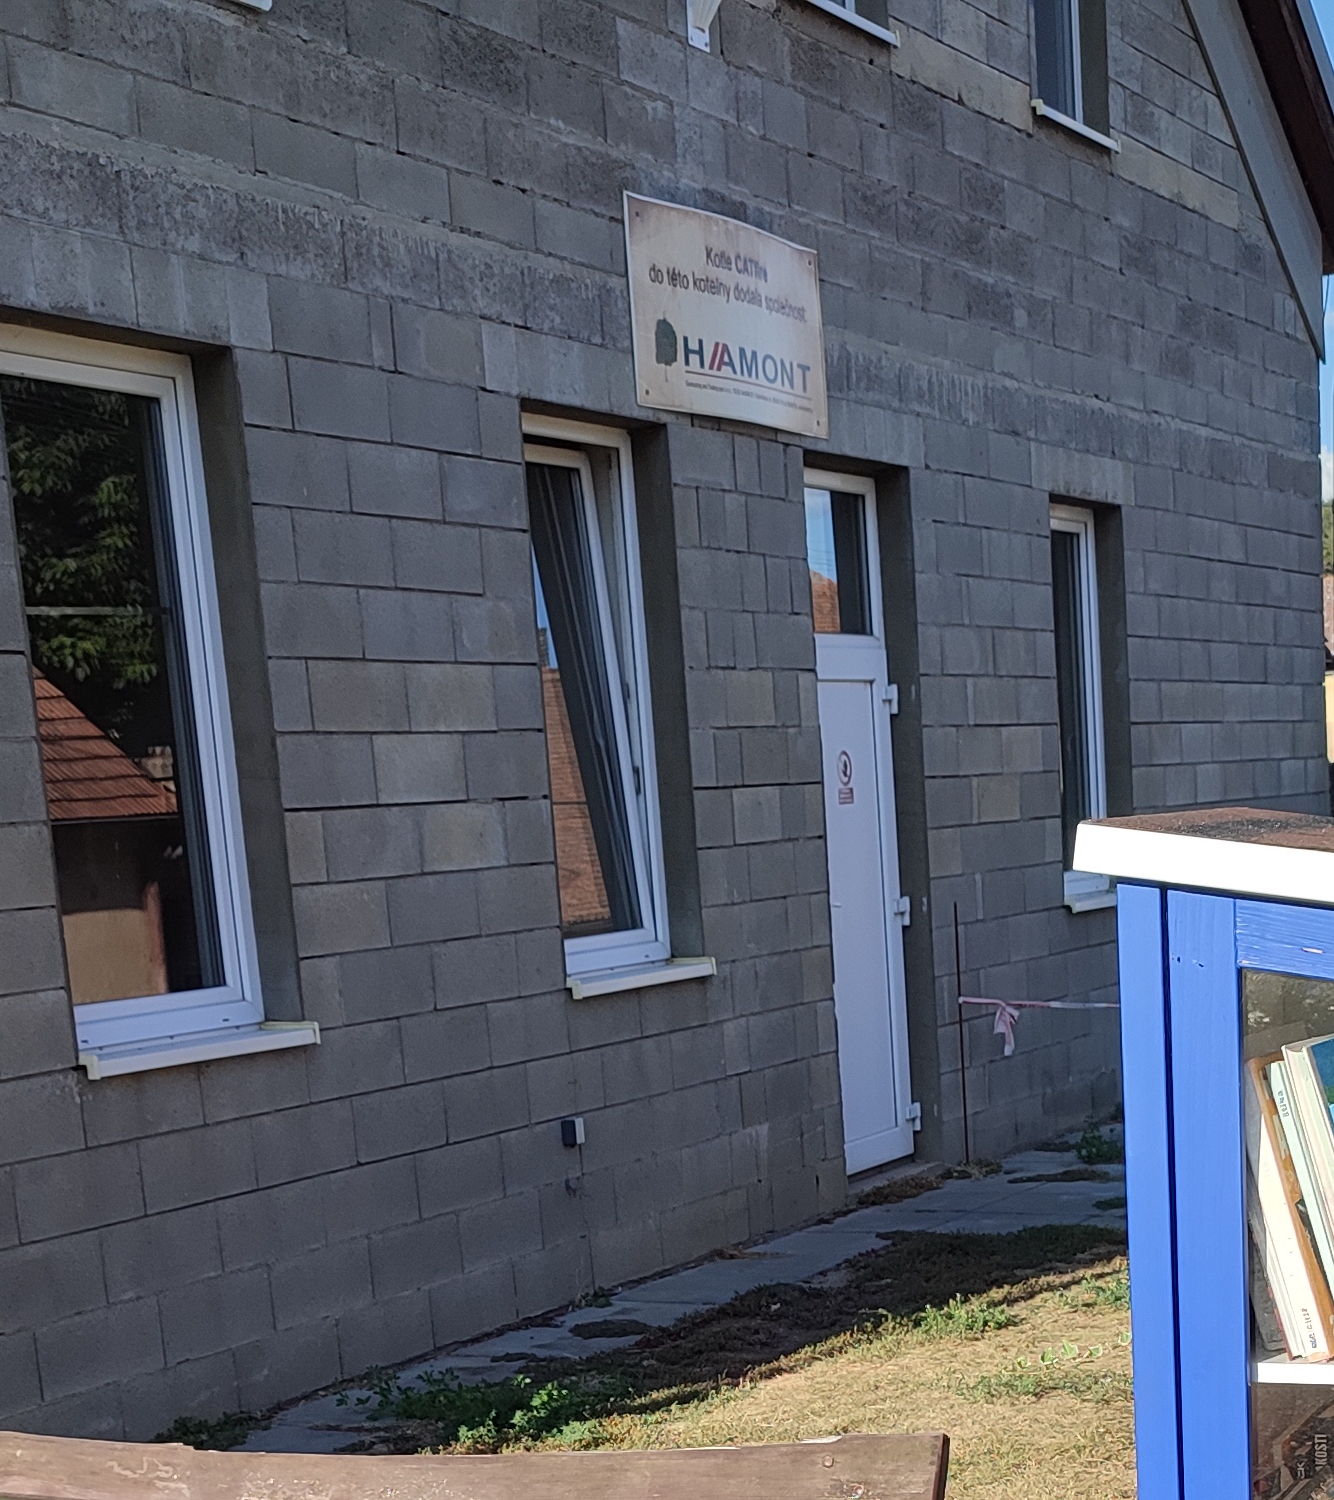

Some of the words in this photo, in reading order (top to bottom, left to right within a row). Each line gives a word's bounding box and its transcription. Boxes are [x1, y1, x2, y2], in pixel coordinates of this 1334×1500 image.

[704, 245, 732, 273] Kotle
[649, 262, 664, 285] do
[665, 265, 690, 291] této
[692, 271, 732, 304] kotelny
[733, 280, 763, 310] dodala
[764, 288, 807, 324] společnost
